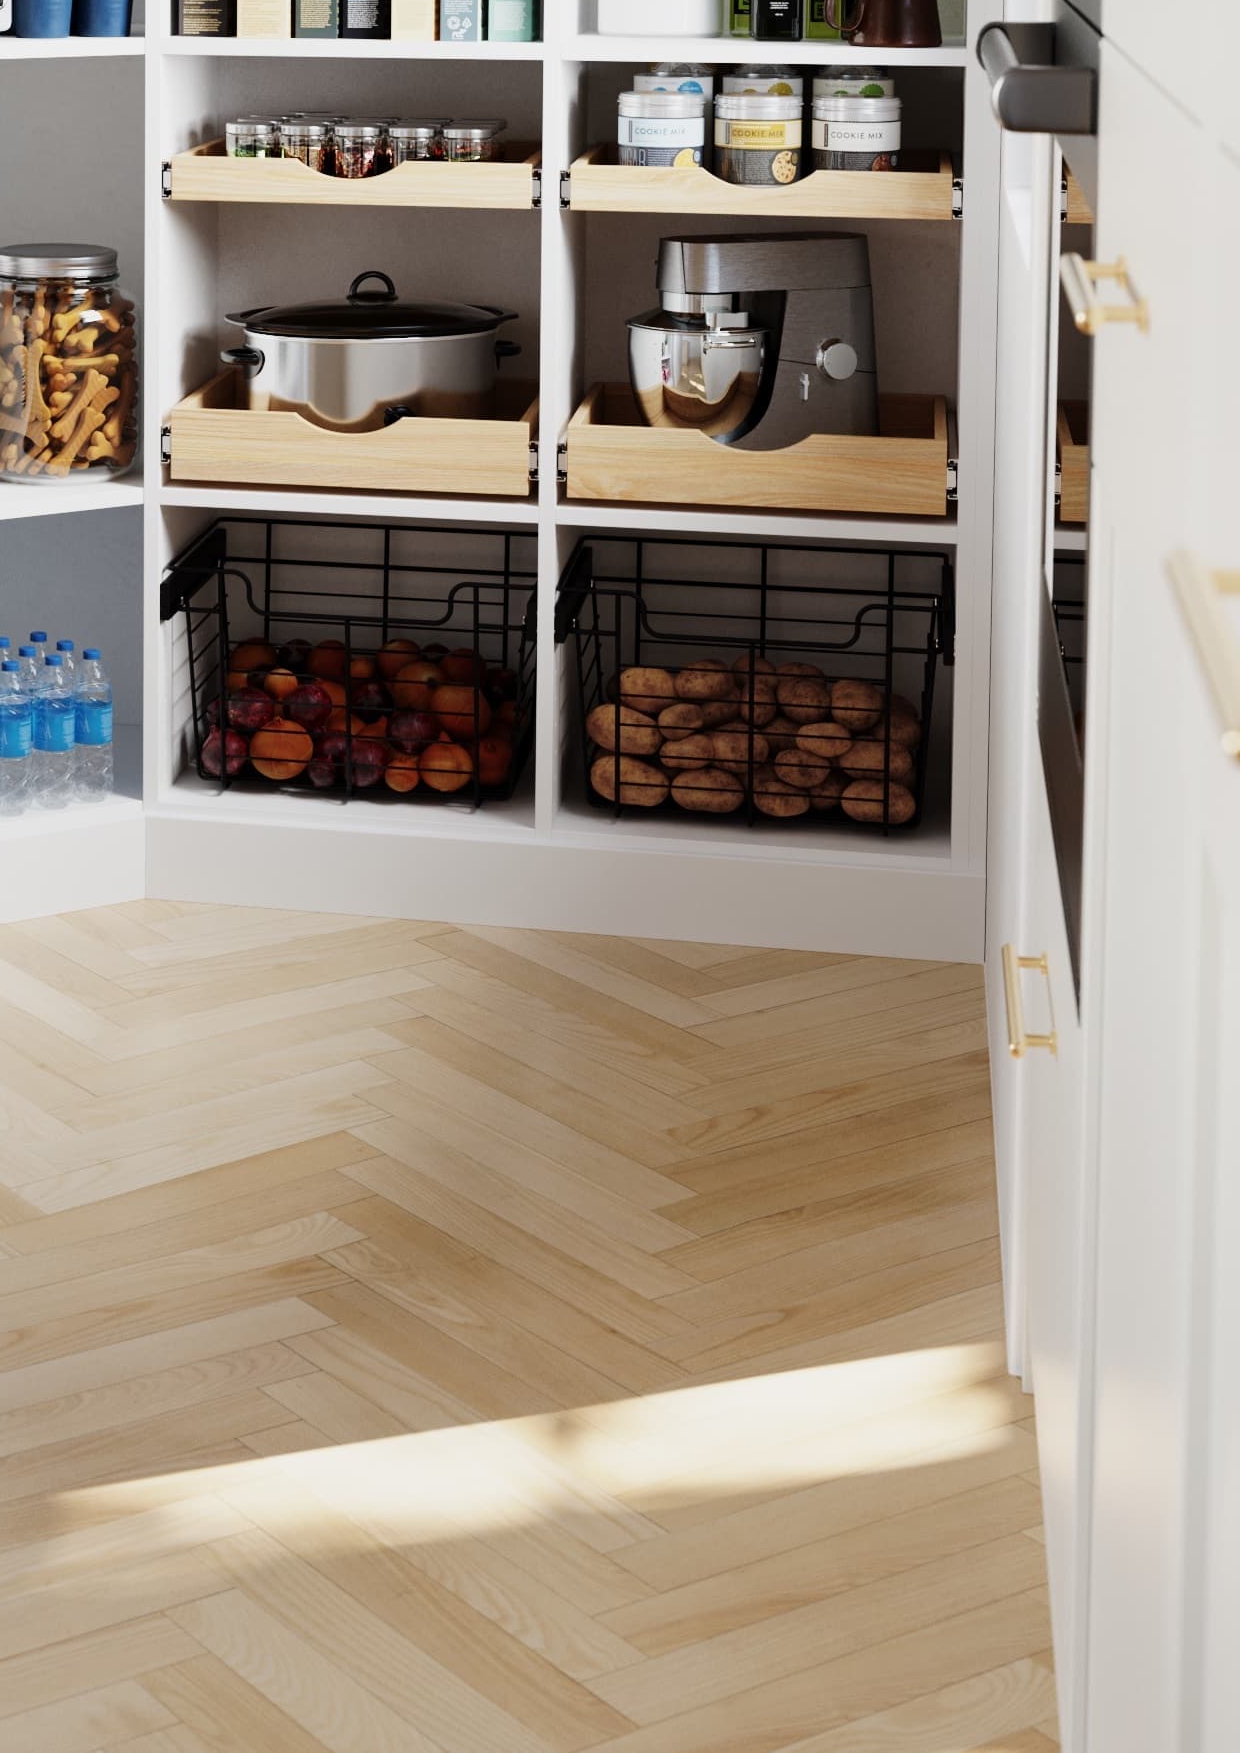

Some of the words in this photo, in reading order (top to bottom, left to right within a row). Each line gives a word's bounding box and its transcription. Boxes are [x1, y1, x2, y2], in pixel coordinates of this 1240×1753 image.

[634, 127, 667, 136] COOKIE
[670, 127, 686, 136] MIX
[731, 128, 765, 137] COOKIE
[767, 129, 784, 137] MIX
[830, 131, 865, 140] COOKIE
[868, 132, 884, 140] MIX
